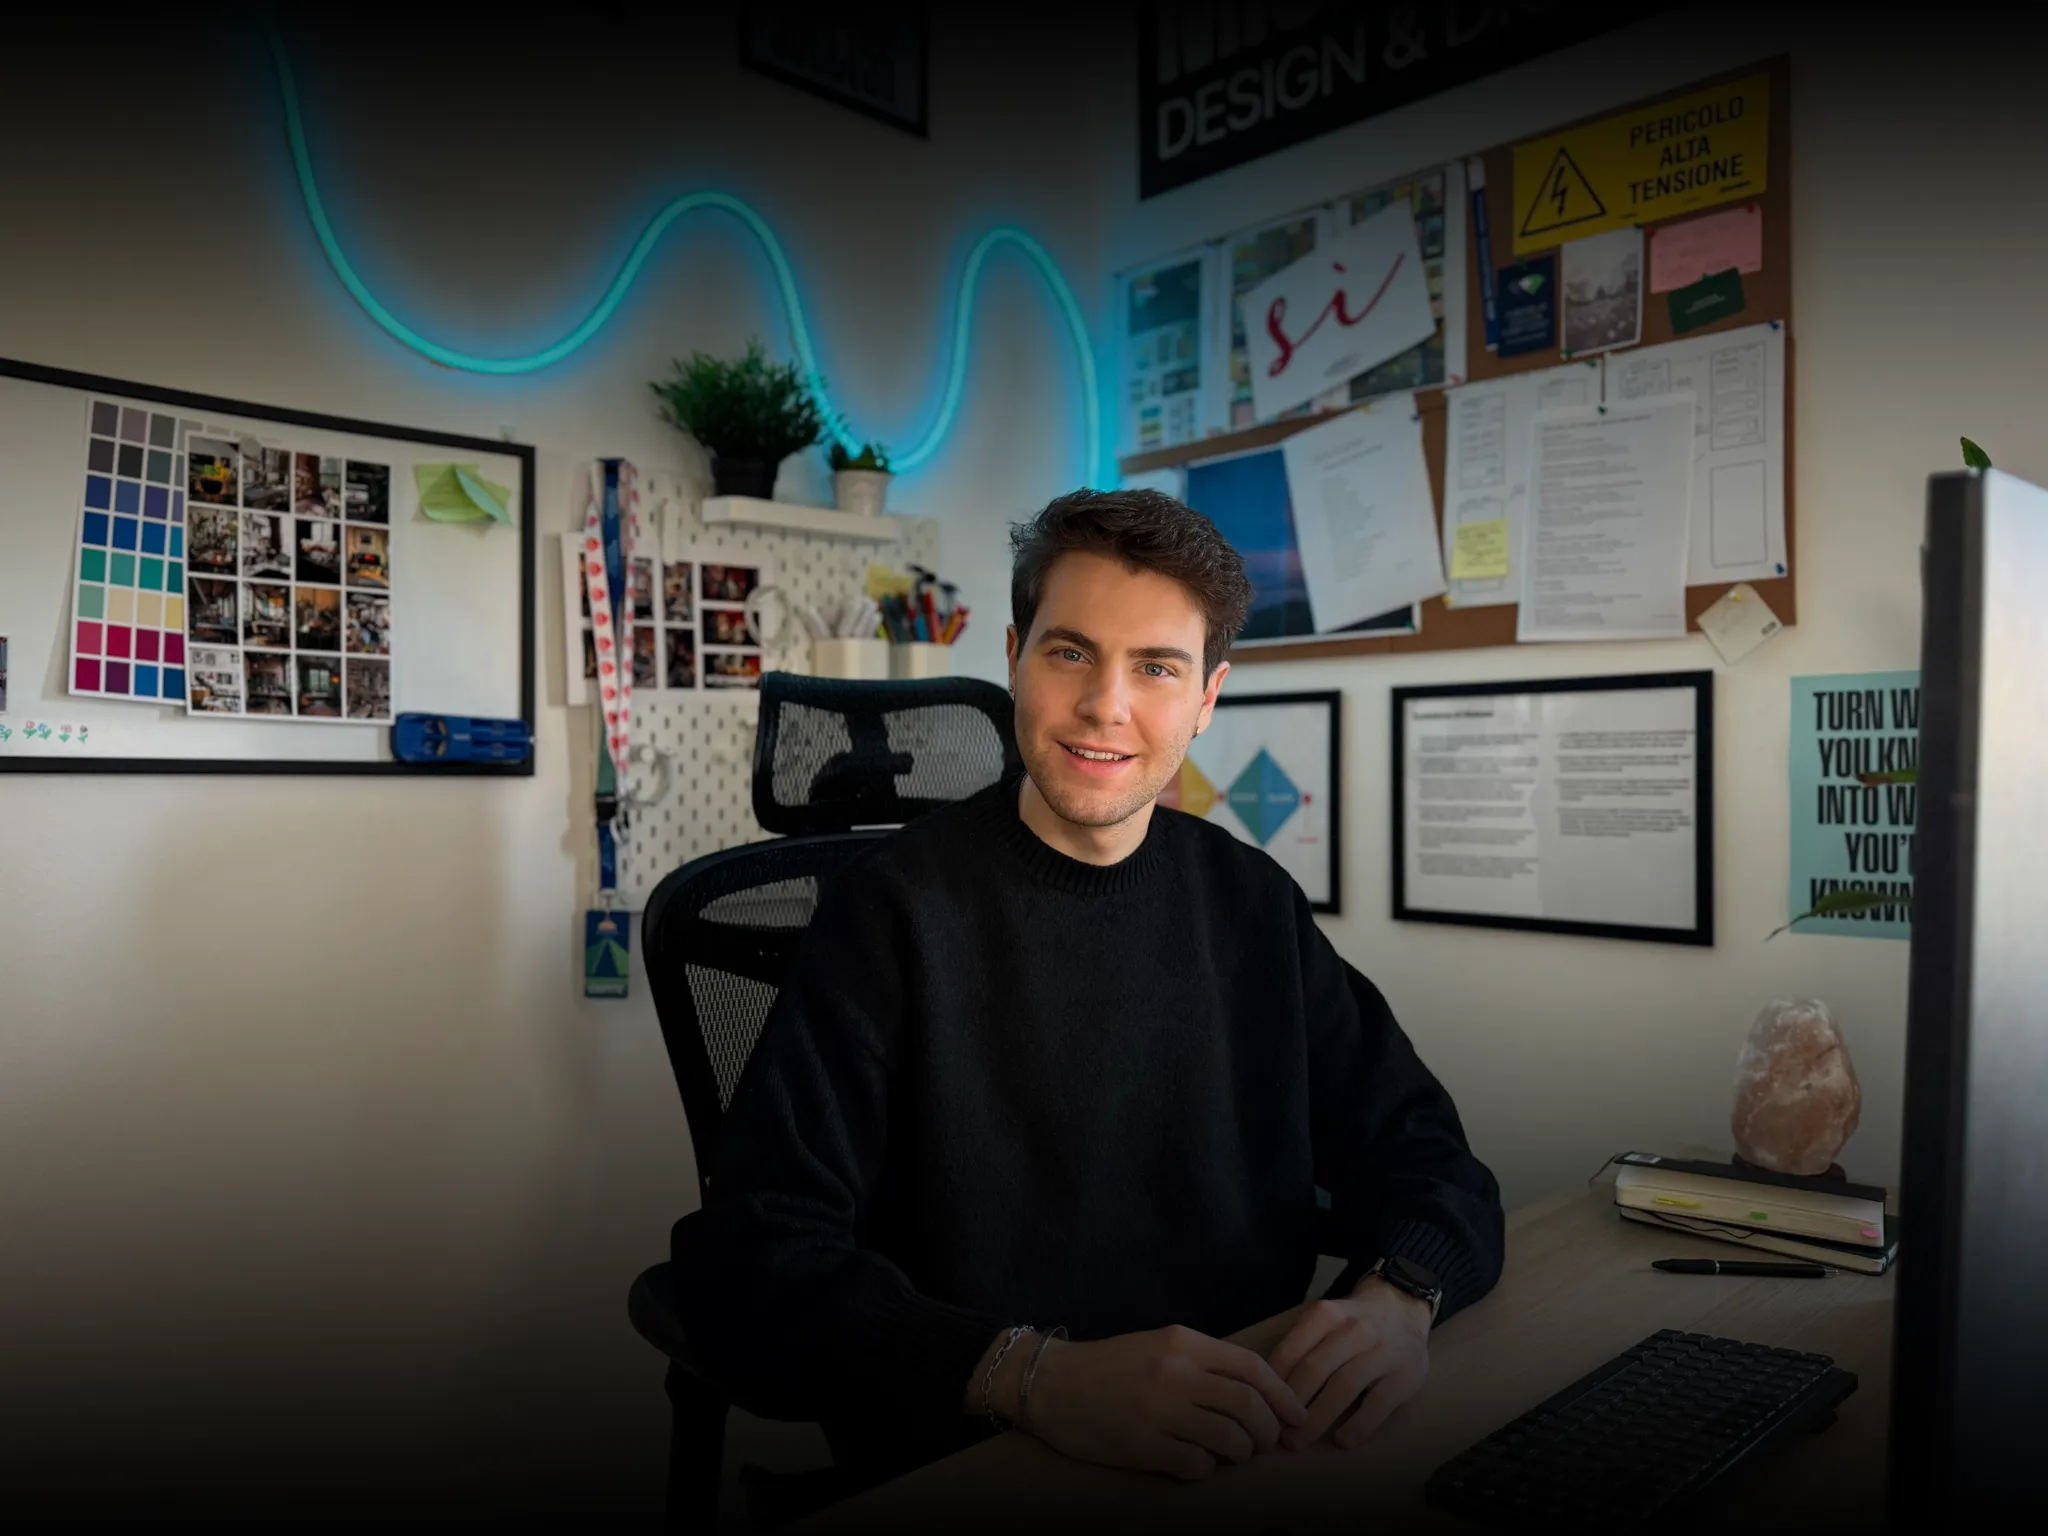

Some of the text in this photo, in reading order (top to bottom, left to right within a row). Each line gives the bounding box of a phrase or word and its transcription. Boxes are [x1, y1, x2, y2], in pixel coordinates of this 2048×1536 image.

[1156, 22, 1366, 162] DESIGN
[1630, 96, 1743, 149] PERICOLO
[1660, 135, 1710, 169] ALTA
[1628, 153, 1743, 204] TENSIONE
[1813, 688, 1920, 731] TURN W
[1818, 736, 1918, 778] YOU KN
[1818, 785, 1916, 825] INTO W
[1845, 832, 1913, 874] YOU'
